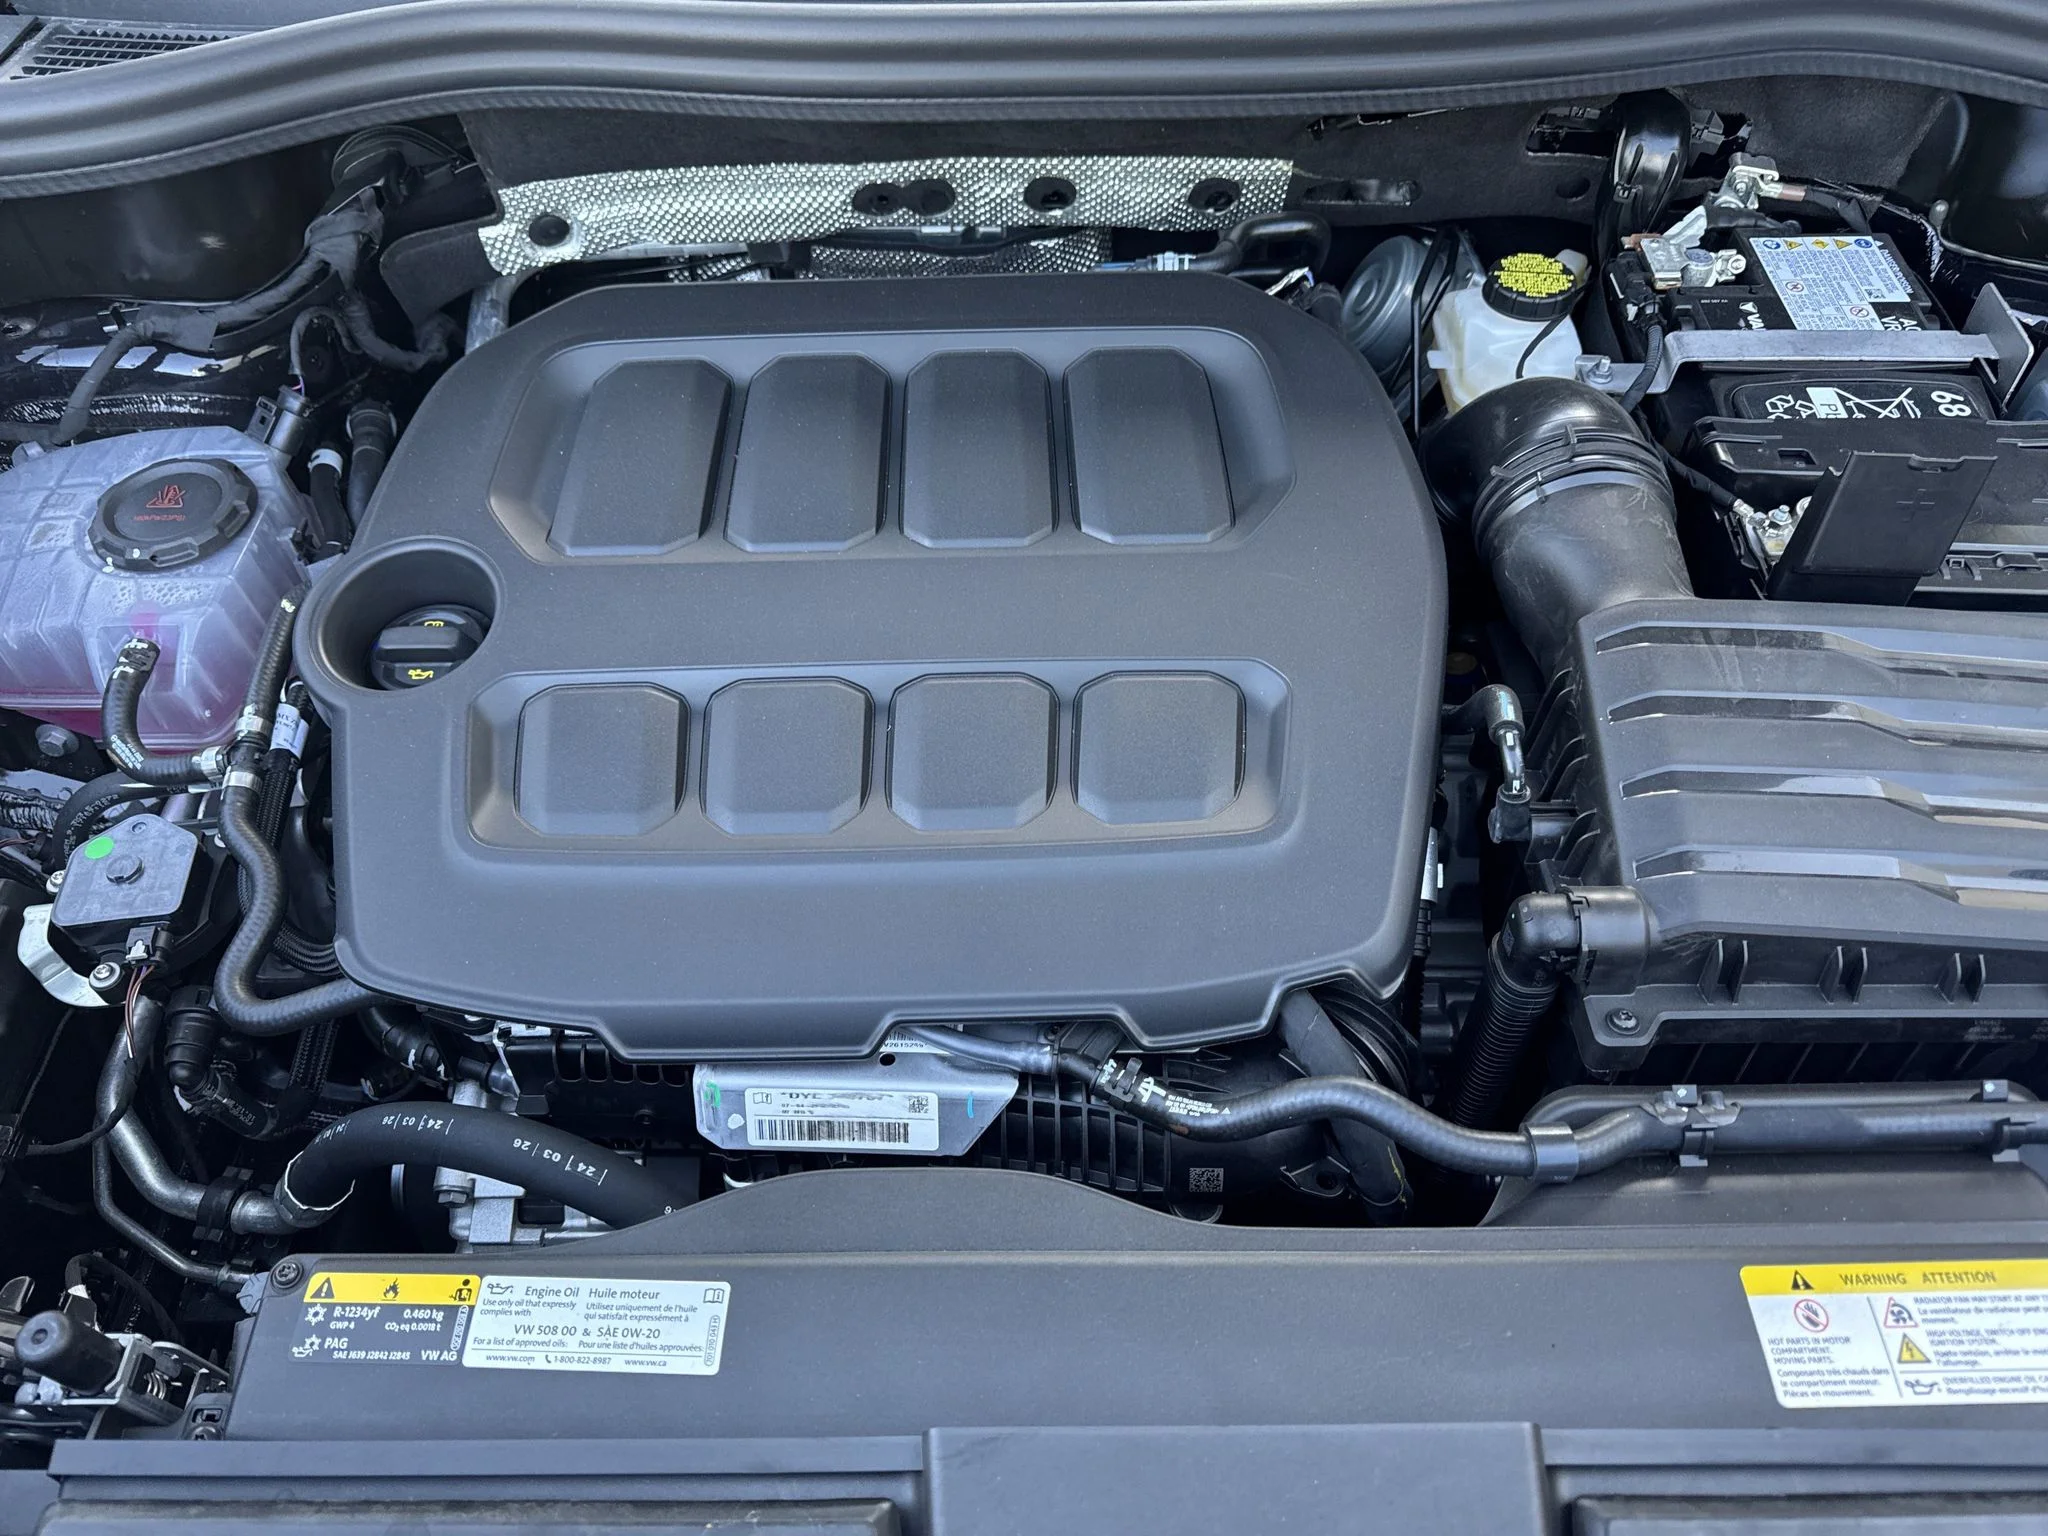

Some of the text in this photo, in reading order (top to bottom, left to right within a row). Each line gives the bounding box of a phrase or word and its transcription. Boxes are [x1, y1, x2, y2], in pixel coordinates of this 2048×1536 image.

[1931, 390, 1972, 417] 68
[402, 1116, 416, 1126] 03
[513, 1138, 596, 1177] 24 03 26
[1839, 1271, 1997, 1286] WARNING ATTENTION
[524, 1286, 580, 1299] Engine Oil
[588, 1288, 660, 1300] Huile moteur
[482, 1298, 577, 1310] Use only oil that expressly
[585, 1302, 698, 1314] Utilisez uniquement de l'huile
[333, 1306, 381, 1319] R-1234yf
[403, 1308, 445, 1322] 0.460 kg
[480, 1307, 532, 1317] complies with
[583, 1312, 597, 1321] qui
[598, 1312, 628, 1321] satisfait
[629, 1313, 683, 1323] expressément
[330, 1321, 355, 1330] GWP 4
[400, 1324, 410, 1332] eq
[411, 1323, 435, 1331] 0.0018
[514, 1324, 661, 1339] VW 508 00 & SAE 0W-20
[324, 1337, 348, 1349] PAG
[472, 1337, 486, 1345] For
[492, 1338, 506, 1346] list
[506, 1338, 516, 1346] of
[516, 1339, 551, 1349] approved
[578, 1340, 596, 1349] Pour
[612, 1341, 628, 1350] liste
[629, 1341, 658, 1350] d'huiles
[1768, 1336, 1851, 1346] HOT PARTS IN MOTOR
[332, 1350, 411, 1360] SAE J639 J2842 J2845
[421, 1350, 458, 1361] VW AG
[486, 1354, 535, 1363] www.vw.com
[554, 1355, 612, 1365] 1-800-822-8987
[1773, 1356, 1806, 1365] MOVING
[624, 1359, 667, 1367] www.vw.ca
[1777, 1366, 1890, 1378] Composants très chauds dans
[1789, 1379, 1847, 1388] compartiment
[1783, 1389, 1809, 1398] Pièces
